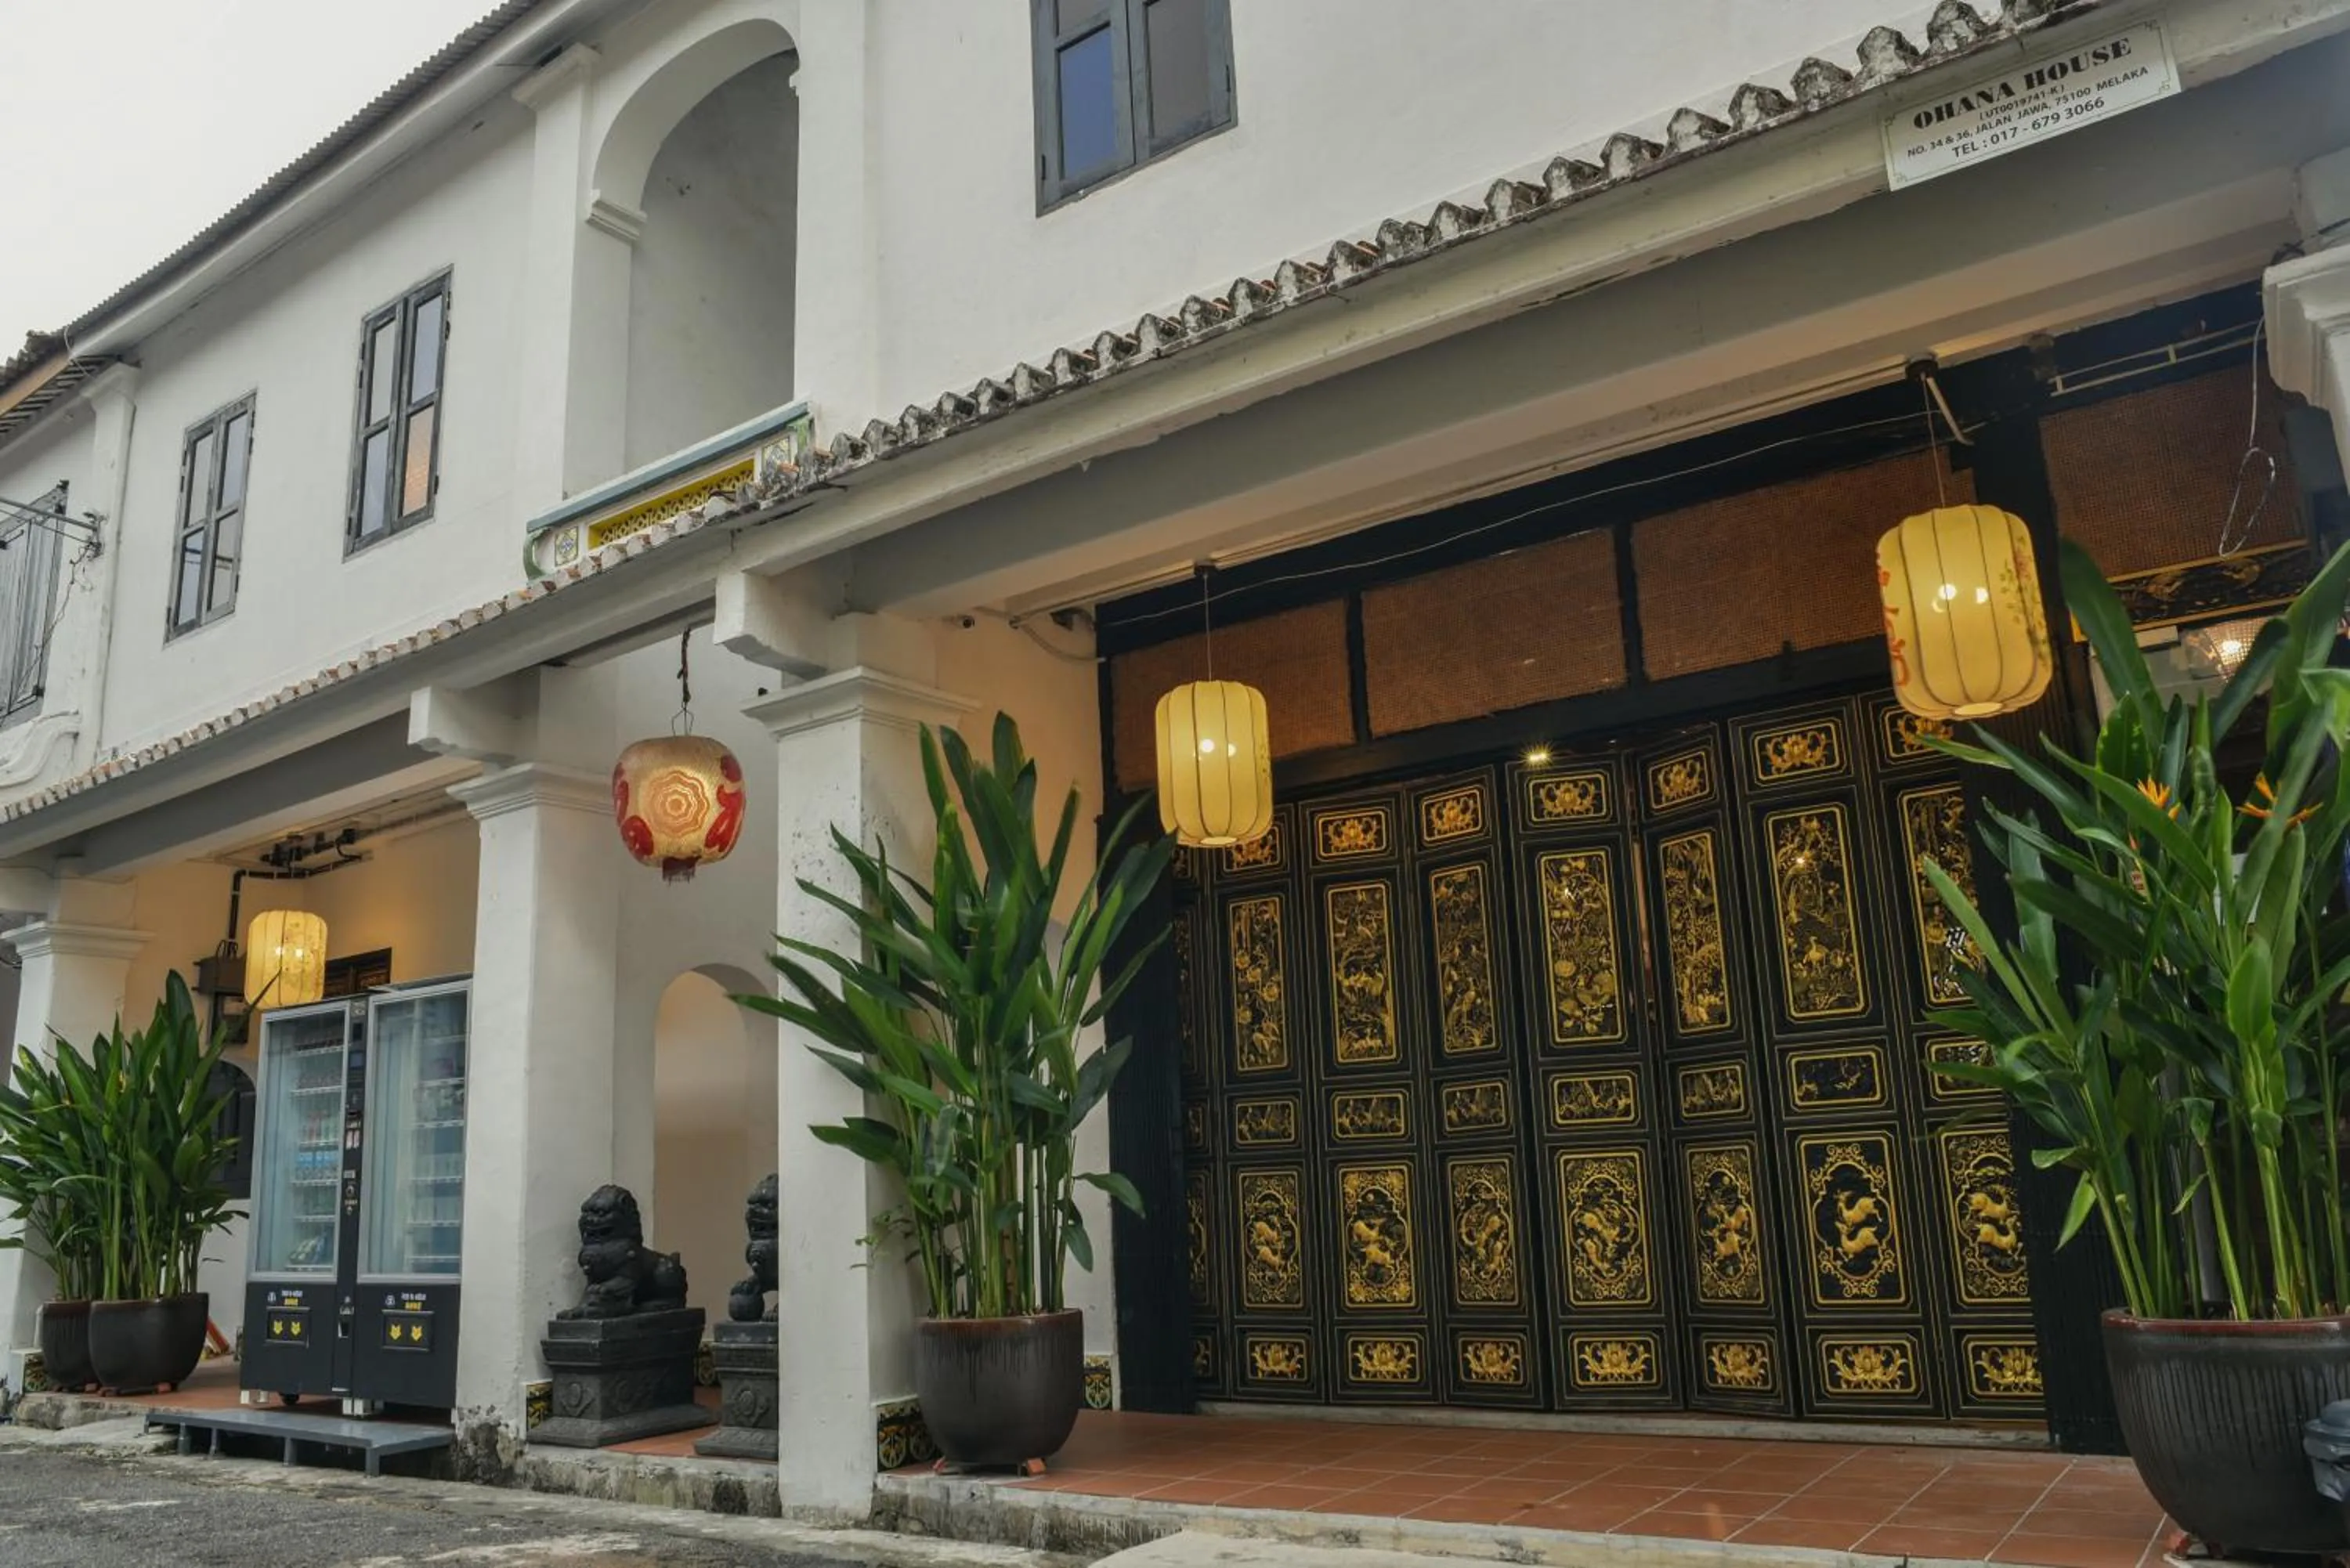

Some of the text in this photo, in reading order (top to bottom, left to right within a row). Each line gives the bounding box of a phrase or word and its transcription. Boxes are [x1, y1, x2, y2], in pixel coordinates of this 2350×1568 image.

[1914, 38, 2131, 129] OHANA HOUSE
[1976, 115, 2012, 135] JALAN
[2055, 87, 2091, 106] 75100
[2097, 66, 2149, 91] MELAKA
[2032, 112, 2060, 131] 679
[2065, 96, 2105, 117] 3066
